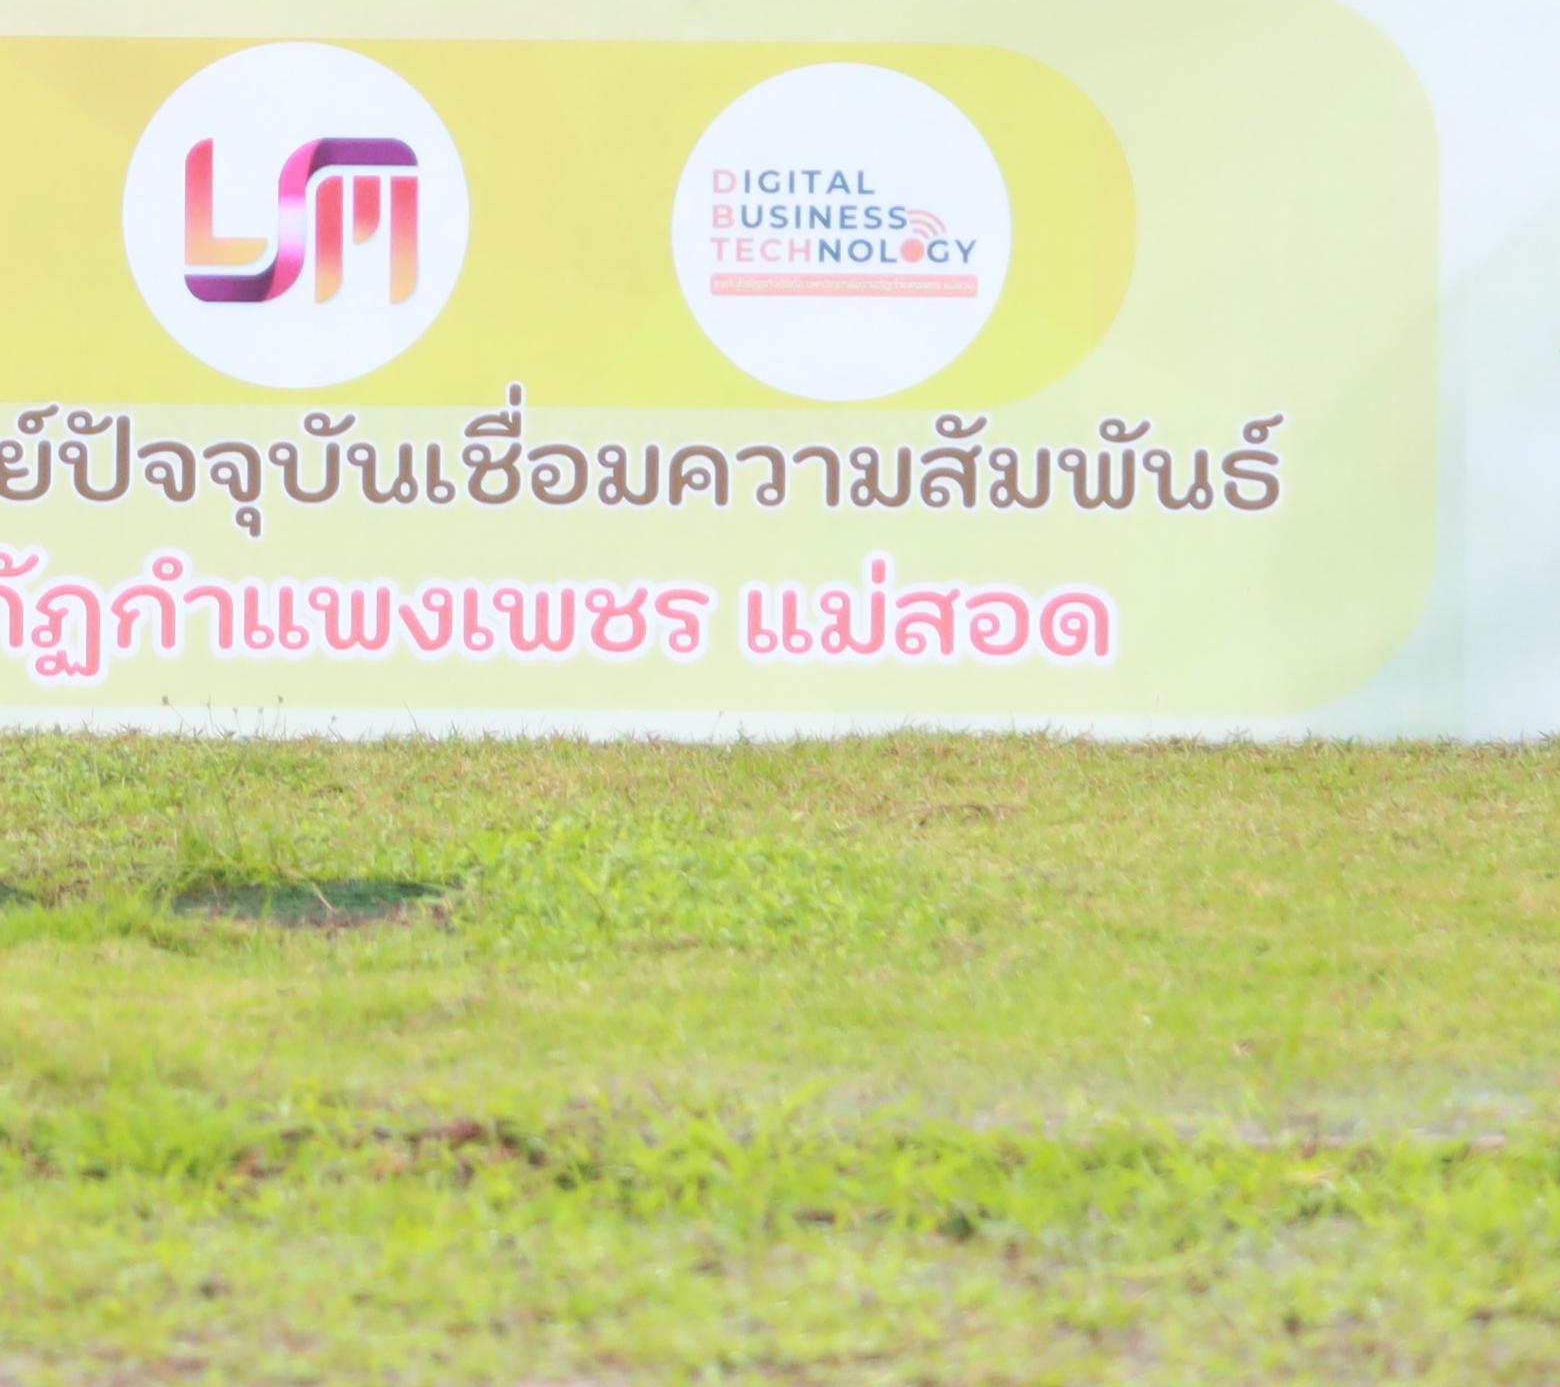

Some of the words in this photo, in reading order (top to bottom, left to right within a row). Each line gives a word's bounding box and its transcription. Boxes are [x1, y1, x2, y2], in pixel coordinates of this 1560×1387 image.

[711, 169, 876, 196] DIGITAL
[711, 204, 909, 231] BUSINESS
[709, 237, 978, 265] TECHNOLOGY
[745, 558, 1111, 659] แม่สอด
